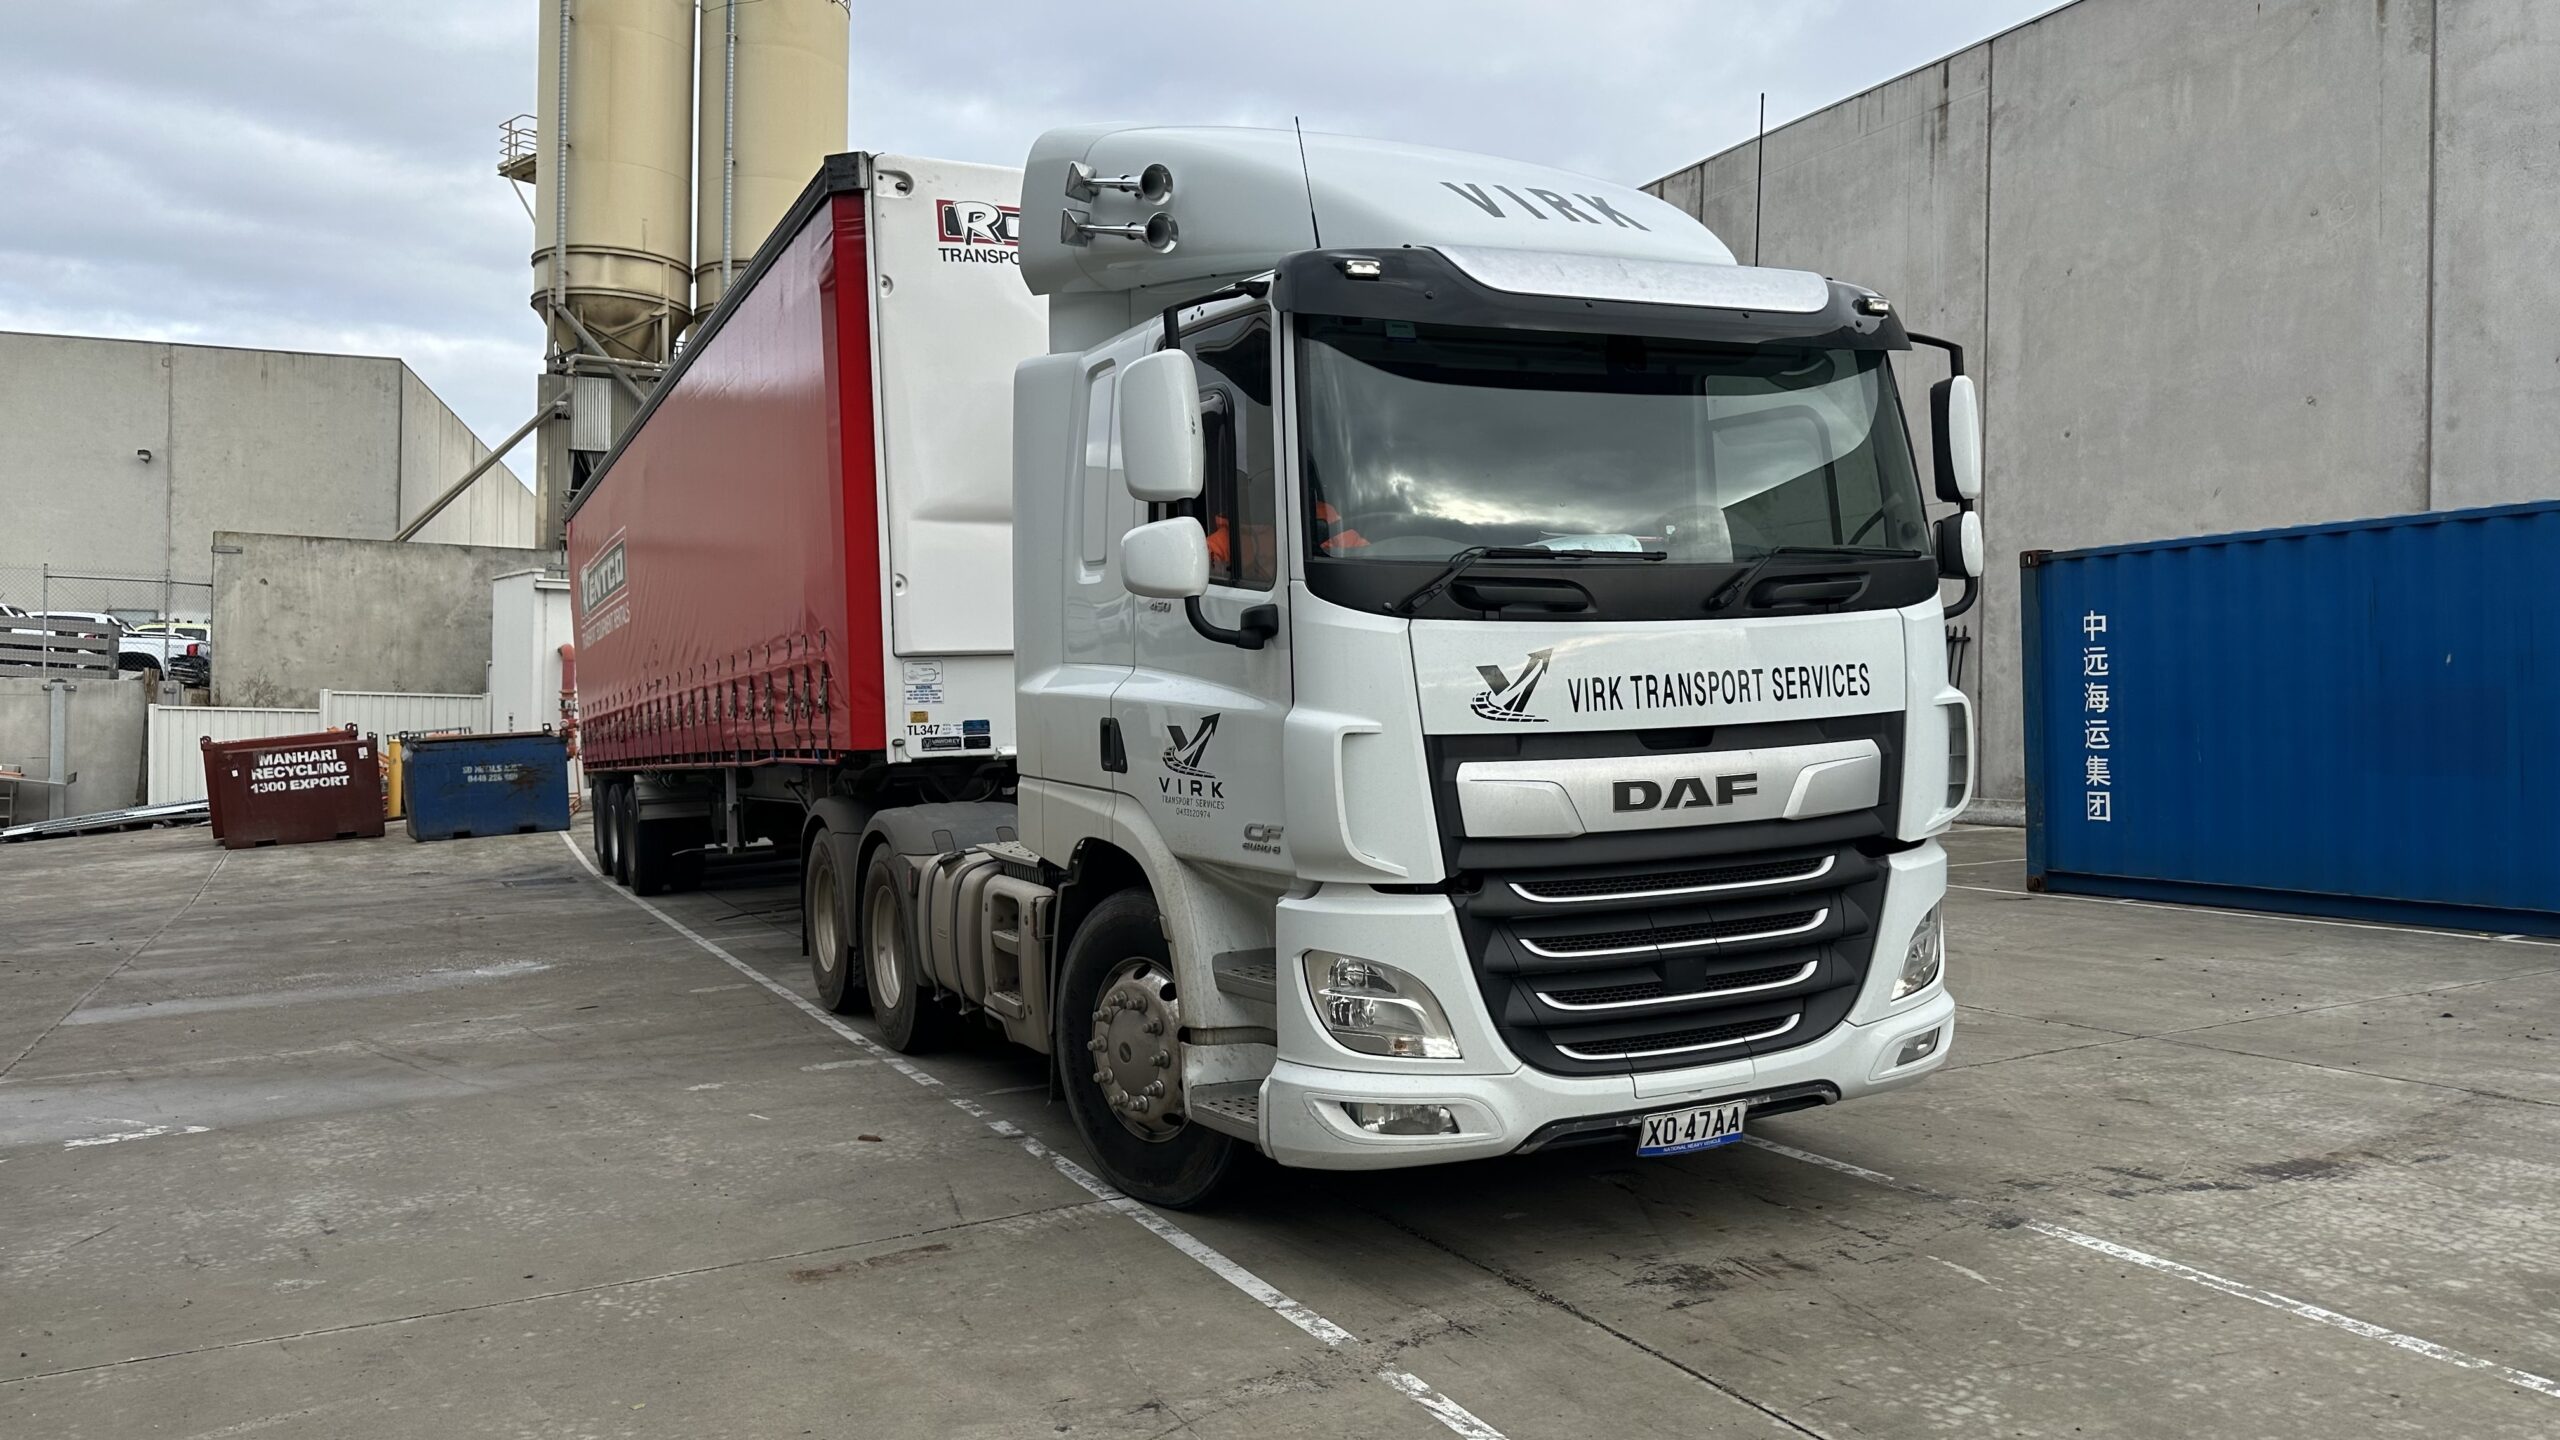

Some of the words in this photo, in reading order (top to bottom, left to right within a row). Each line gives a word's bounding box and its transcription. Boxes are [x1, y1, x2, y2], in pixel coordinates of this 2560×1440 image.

[1439, 181, 1652, 232] VIRK
[1568, 676, 1624, 713] VIRK
[1630, 668, 1764, 711] TRANSPORT
[1772, 662, 1871, 701] SERVICES
[2083, 610, 2111, 822] 中远海运集团
[907, 724, 940, 736] TL347
[258, 749, 338, 767] MANHARI
[251, 761, 347, 781] RECYCLING
[250, 781, 287, 794] 1300
[290, 775, 350, 790] EXPORT
[1159, 777, 1224, 799] VIRK
[1612, 772, 1758, 814] DAF
[1162, 795, 1193, 806] TRANSPORT
[1195, 799, 1225, 810] SERVICES
[1244, 823, 1284, 843] CF
[1663, 1144, 1686, 1152] NATIONAL
